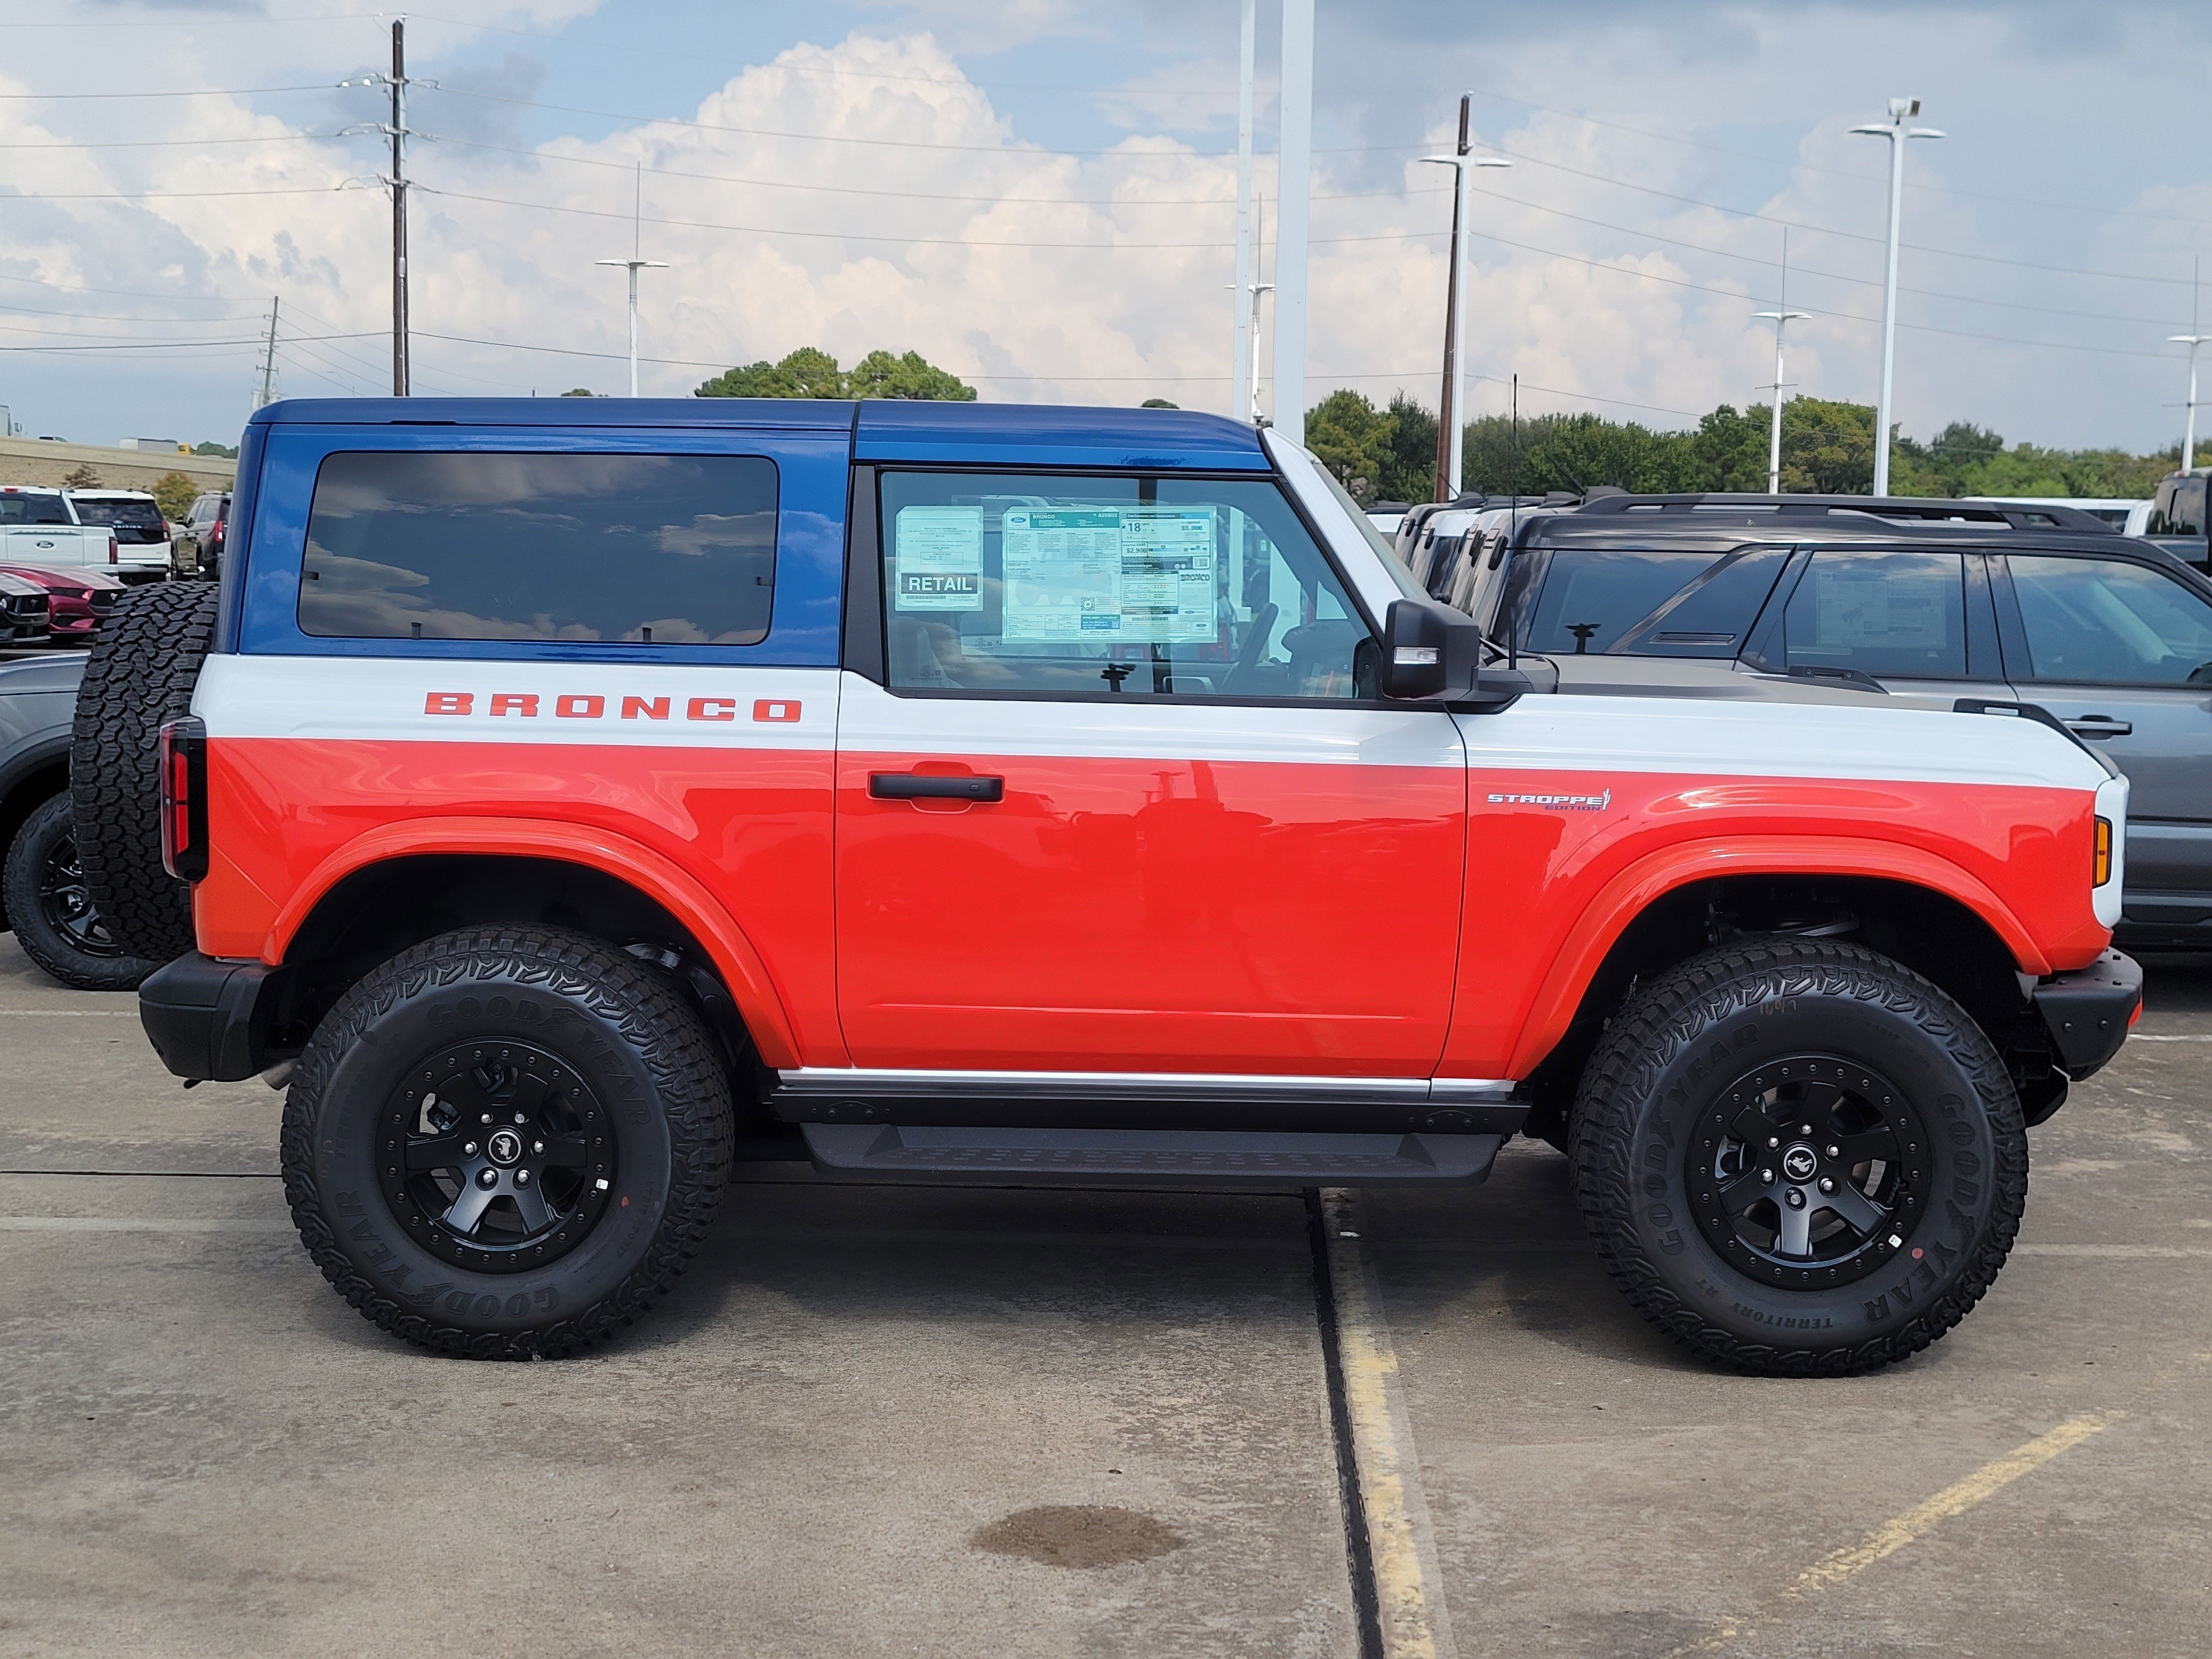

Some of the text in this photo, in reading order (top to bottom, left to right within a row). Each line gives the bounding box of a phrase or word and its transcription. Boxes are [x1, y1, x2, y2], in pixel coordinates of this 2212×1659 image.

[1127, 522, 1141, 532] 18
[909, 577, 973, 591] RETAIL
[424, 692, 802, 723] BRONCO
[1487, 794, 1603, 805] STROPPE
[1696, 1277, 1834, 1329] TERRITORY RT
